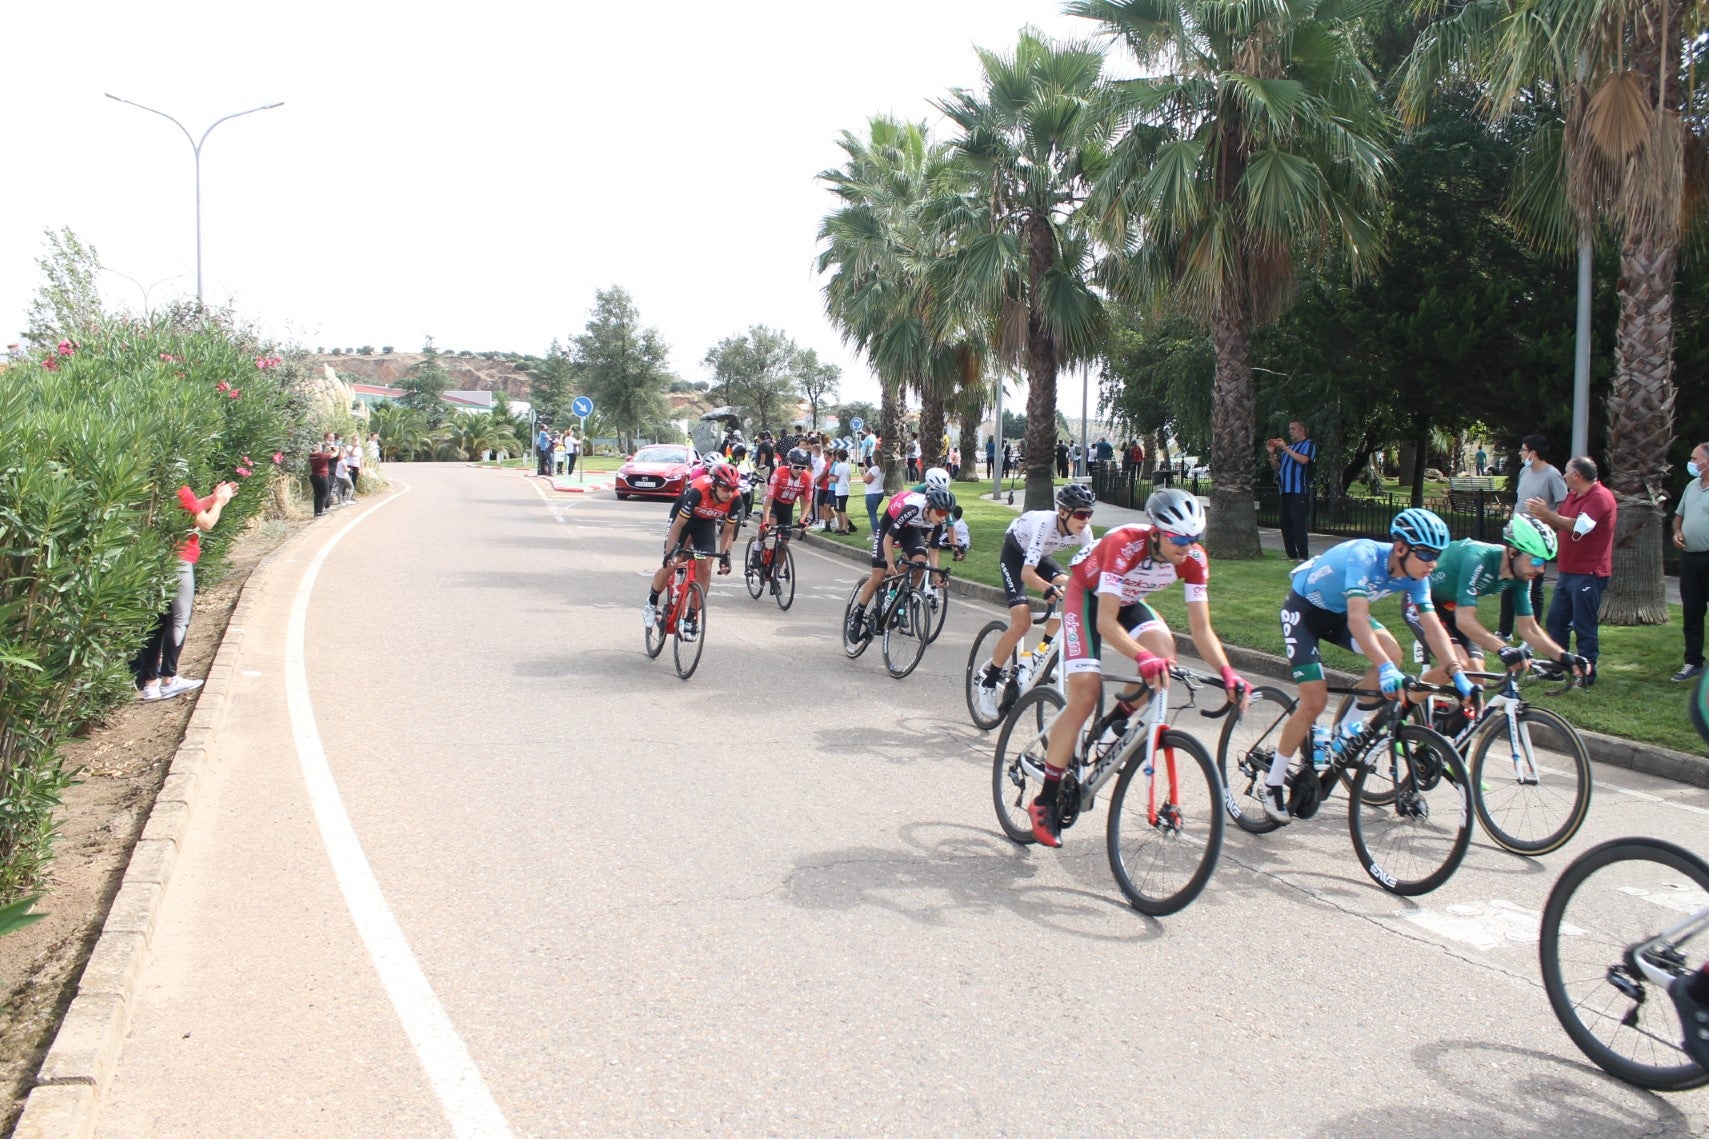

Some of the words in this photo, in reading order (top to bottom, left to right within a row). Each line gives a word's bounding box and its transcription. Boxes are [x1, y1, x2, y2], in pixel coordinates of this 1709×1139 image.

[1064, 612, 1081, 657] telcom
[1088, 720, 1145, 785] ORBEA
[1369, 862, 1398, 889] ENVE
